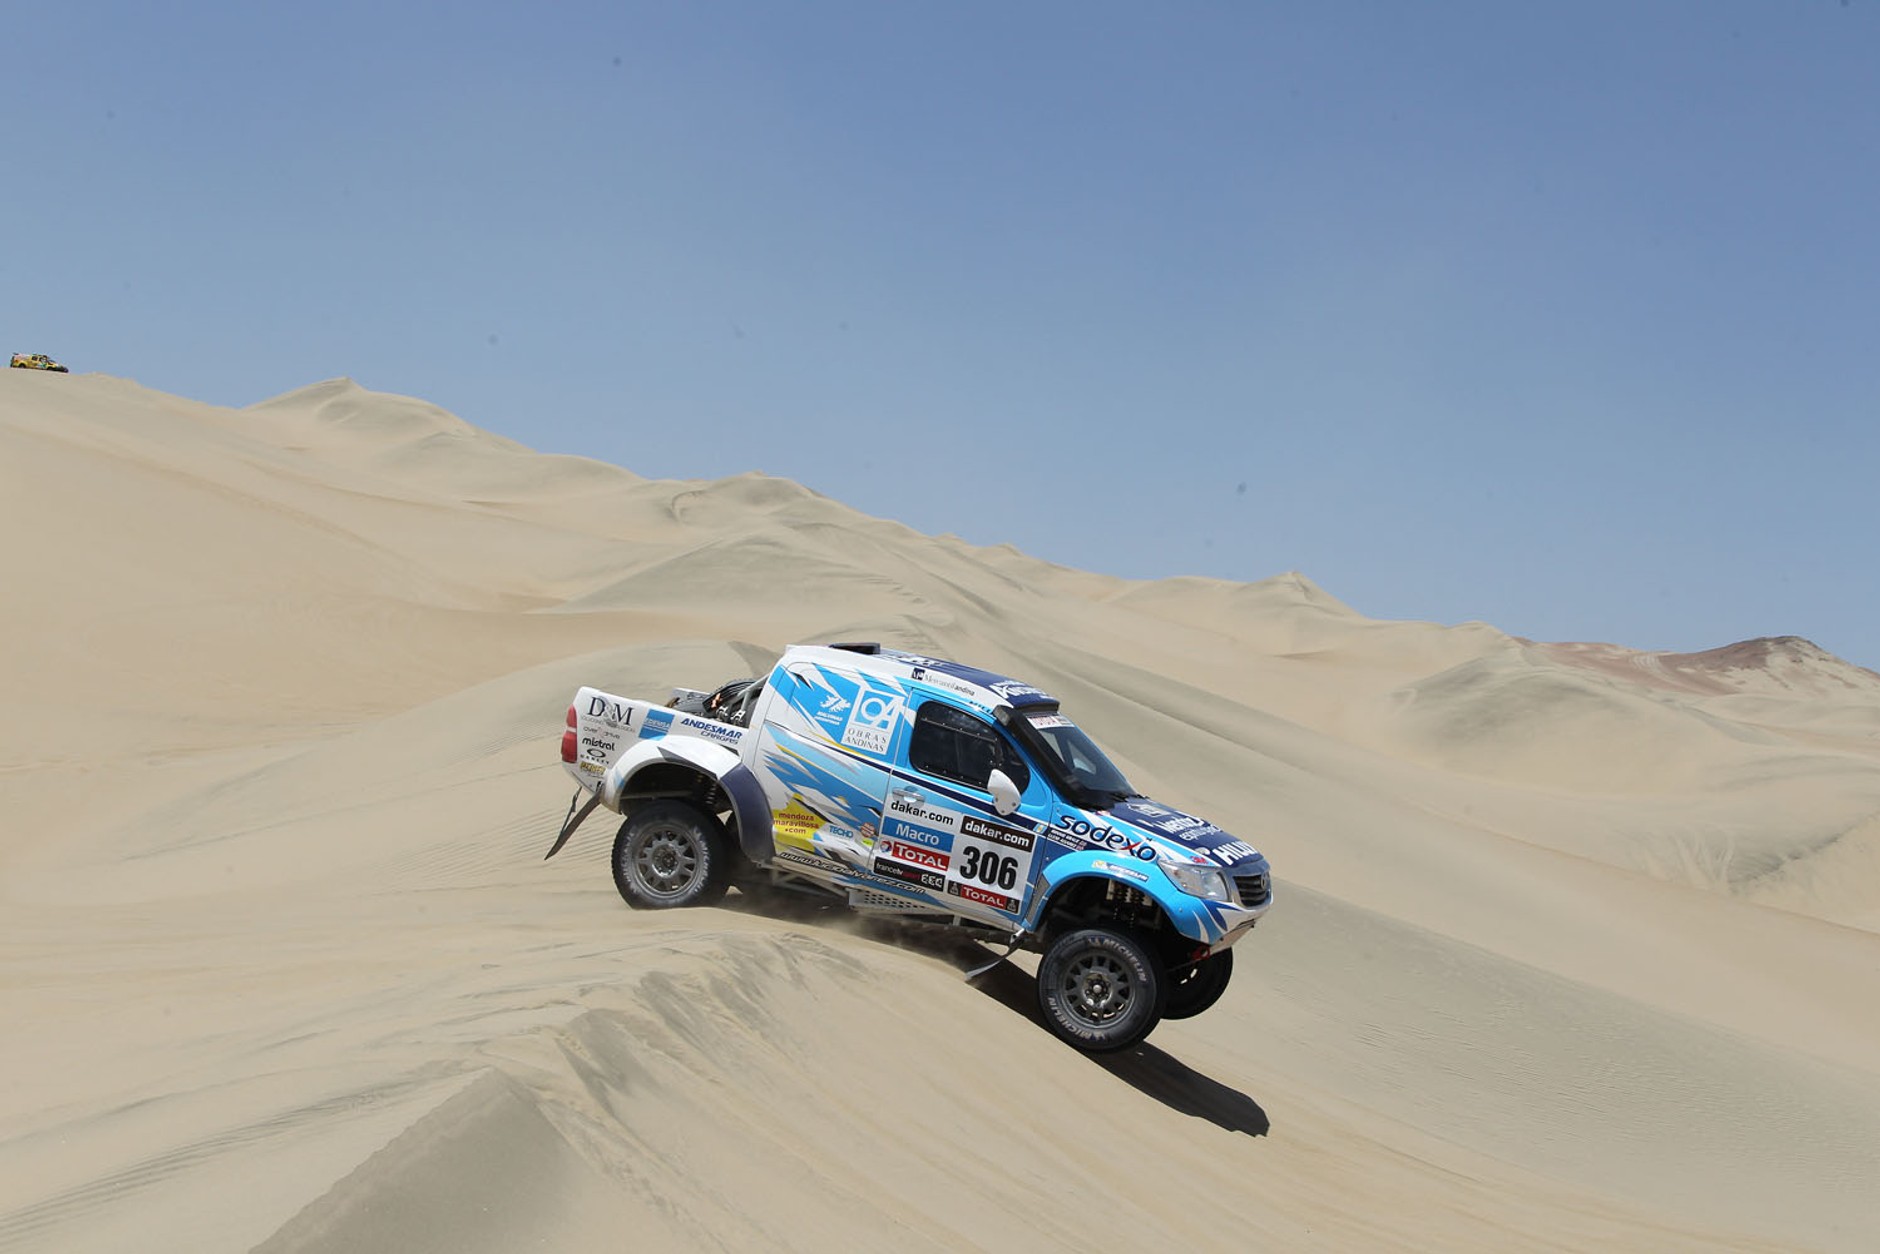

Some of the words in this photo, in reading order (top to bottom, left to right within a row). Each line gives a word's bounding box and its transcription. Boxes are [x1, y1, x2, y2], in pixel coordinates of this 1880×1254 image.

[680, 717, 743, 739] ANDESMAR
[847, 727, 888, 744] OBRAS
[582, 737, 616, 752] mistral
[845, 736, 885, 753] ANDINAS
[773, 819, 820, 830] maravillosa
[778, 811, 815, 822] mendoza
[890, 800, 954, 826] dakar.com
[895, 822, 940, 847] Macro
[964, 819, 1030, 848] dakar.com
[1055, 815, 1157, 862] sodexo
[895, 843, 947, 870] TOTAL
[959, 845, 1019, 891] 306
[963, 886, 1005, 908] TOTAL
[1046, 996, 1093, 1041] MICHELIN
